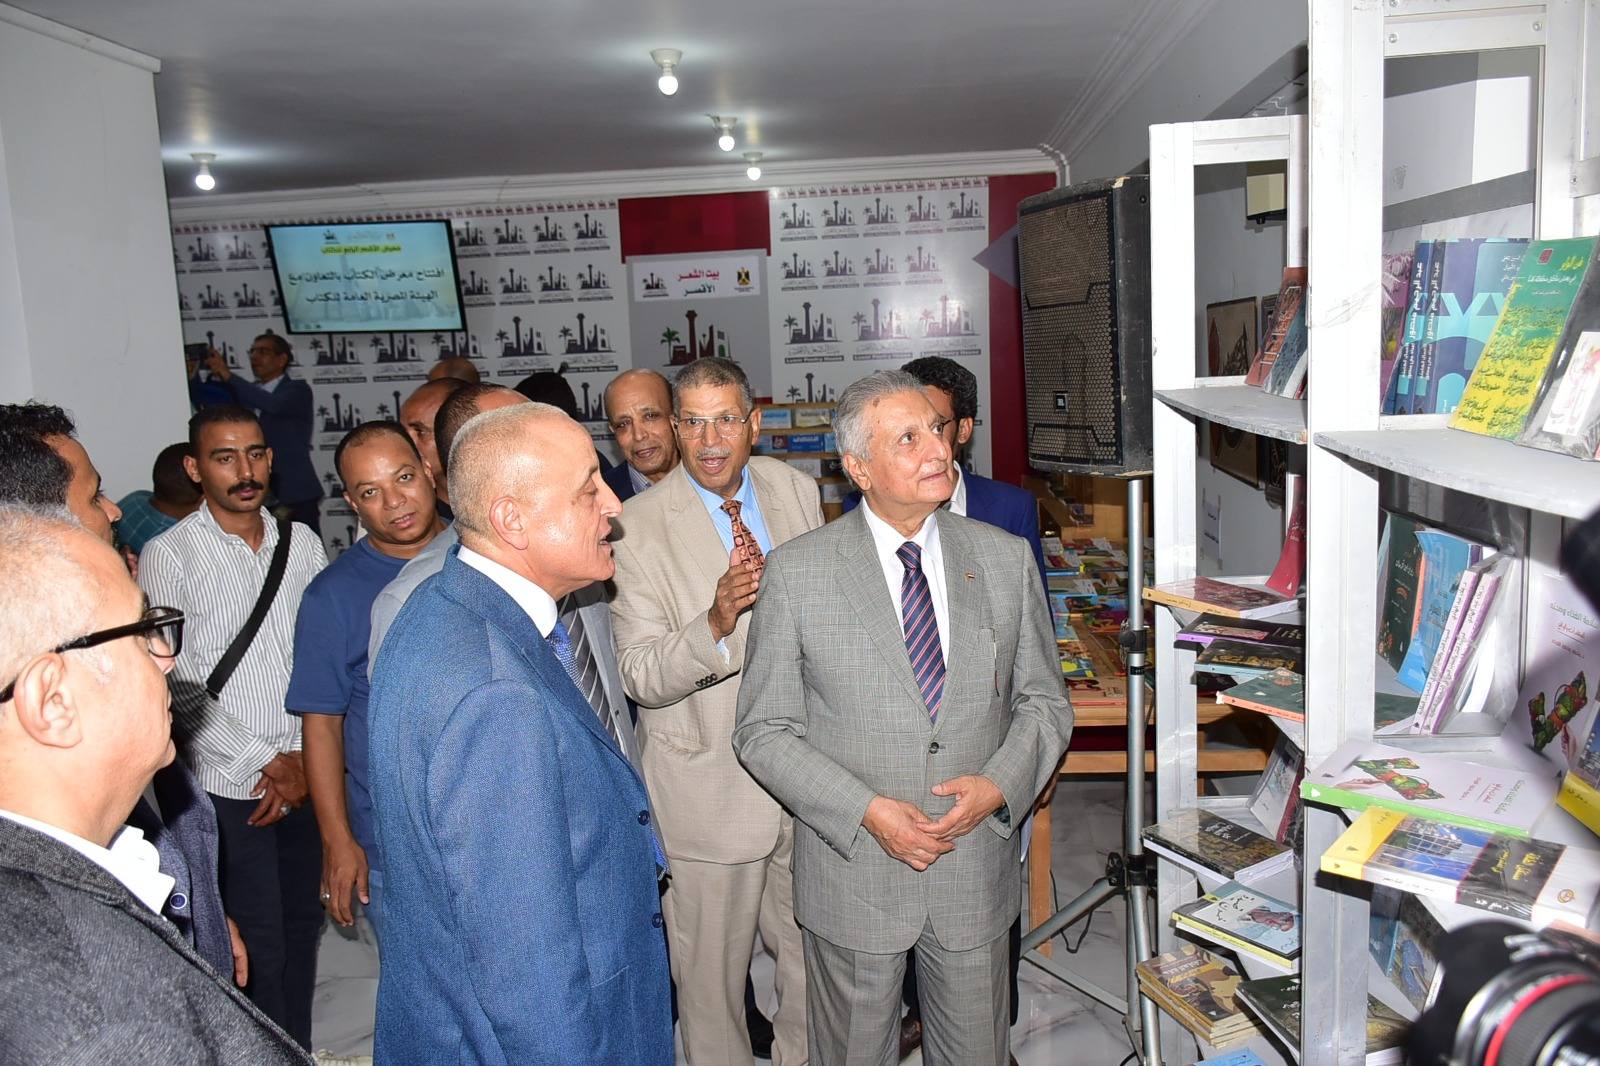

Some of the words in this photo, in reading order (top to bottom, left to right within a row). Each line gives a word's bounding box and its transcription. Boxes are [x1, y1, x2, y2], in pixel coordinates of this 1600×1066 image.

[288, 272, 303, 285] مع
[304, 269, 342, 283] بالتعاون
[344, 268, 379, 281] الكتاب
[380, 268, 414, 281] معرض
[415, 267, 445, 281] افتتاح
[677, 267, 704, 282] الشعر
[705, 268, 720, 281] بيت
[305, 291, 341, 303] للكتاب
[343, 290, 373, 302] العامة
[373, 290, 408, 303] المصرية
[409, 289, 439, 302] الهيئة
[1412, 280, 1422, 311] الرحيم
[1430, 280, 1439, 311] الرحيم
[1408, 311, 1418, 339] منصور
[1426, 311, 1435, 339] منصور
